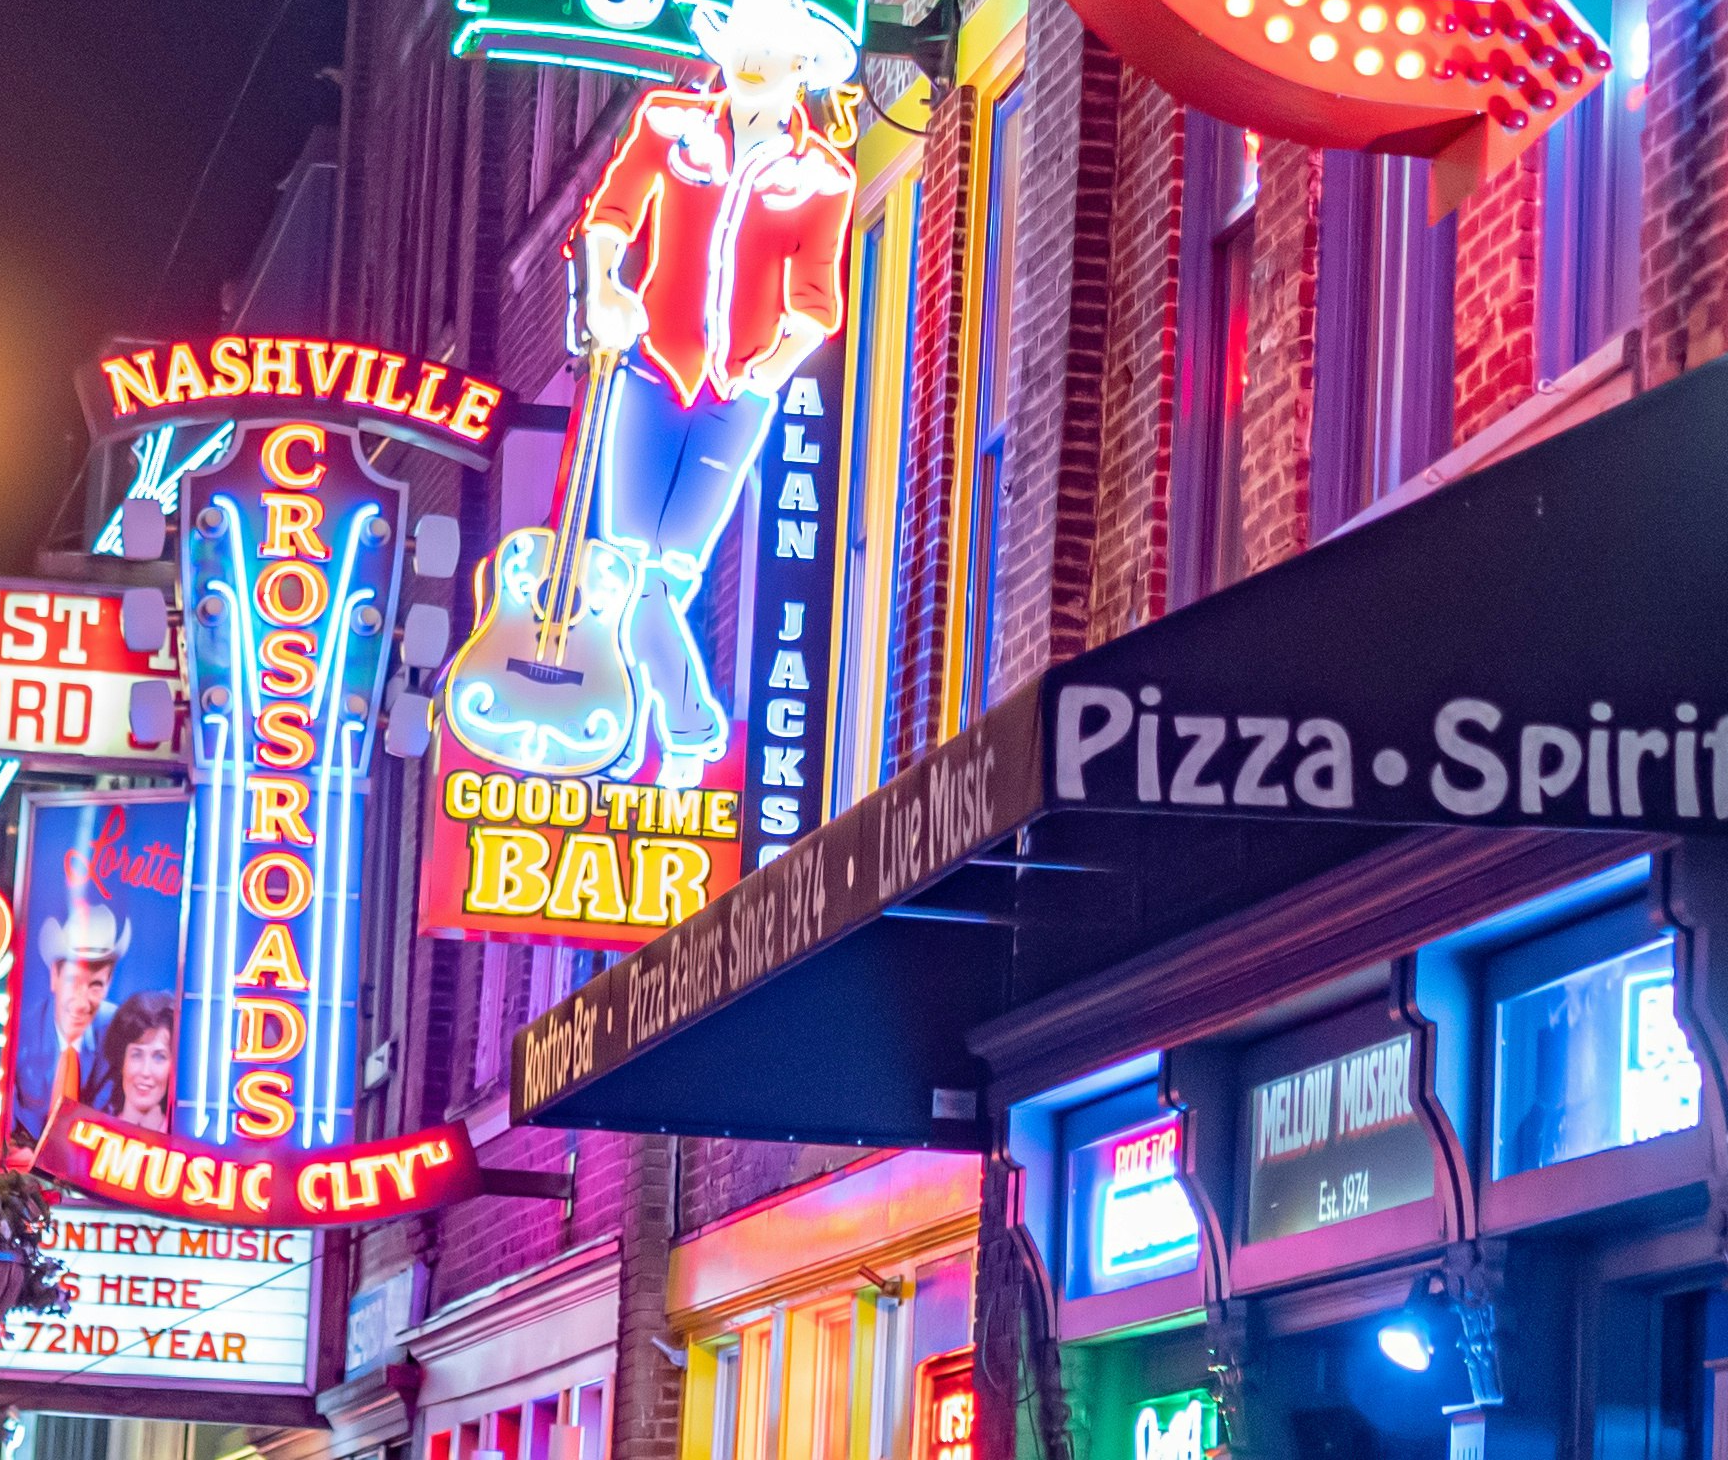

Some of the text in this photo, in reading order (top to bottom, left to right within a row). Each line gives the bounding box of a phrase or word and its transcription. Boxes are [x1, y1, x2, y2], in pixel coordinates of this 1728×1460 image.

[101, 335, 502, 444] NASHVILLE
[775, 375, 824, 561] ALAN
[232, 423, 330, 1142] CROSSROADS
[1056, 685, 1354, 809] Pizza
[63, 804, 183, 900] Loretta
[445, 771, 739, 839] GOOD TIME
[465, 827, 711, 927] BAR
[524, 731, 995, 1111] Rooftop Bar Pizza Bakers Since 1974 Live Music
[1259, 1064, 1333, 1161] MELLOW
[37, 1220, 294, 1263] UNTRY MUSIC
[1318, 1168, 1369, 1223] Est. 1974
[98, 1274, 202, 1310] HERE
[24, 1322, 119, 1357] 72ND
[140, 1326, 247, 1363] YEAR
